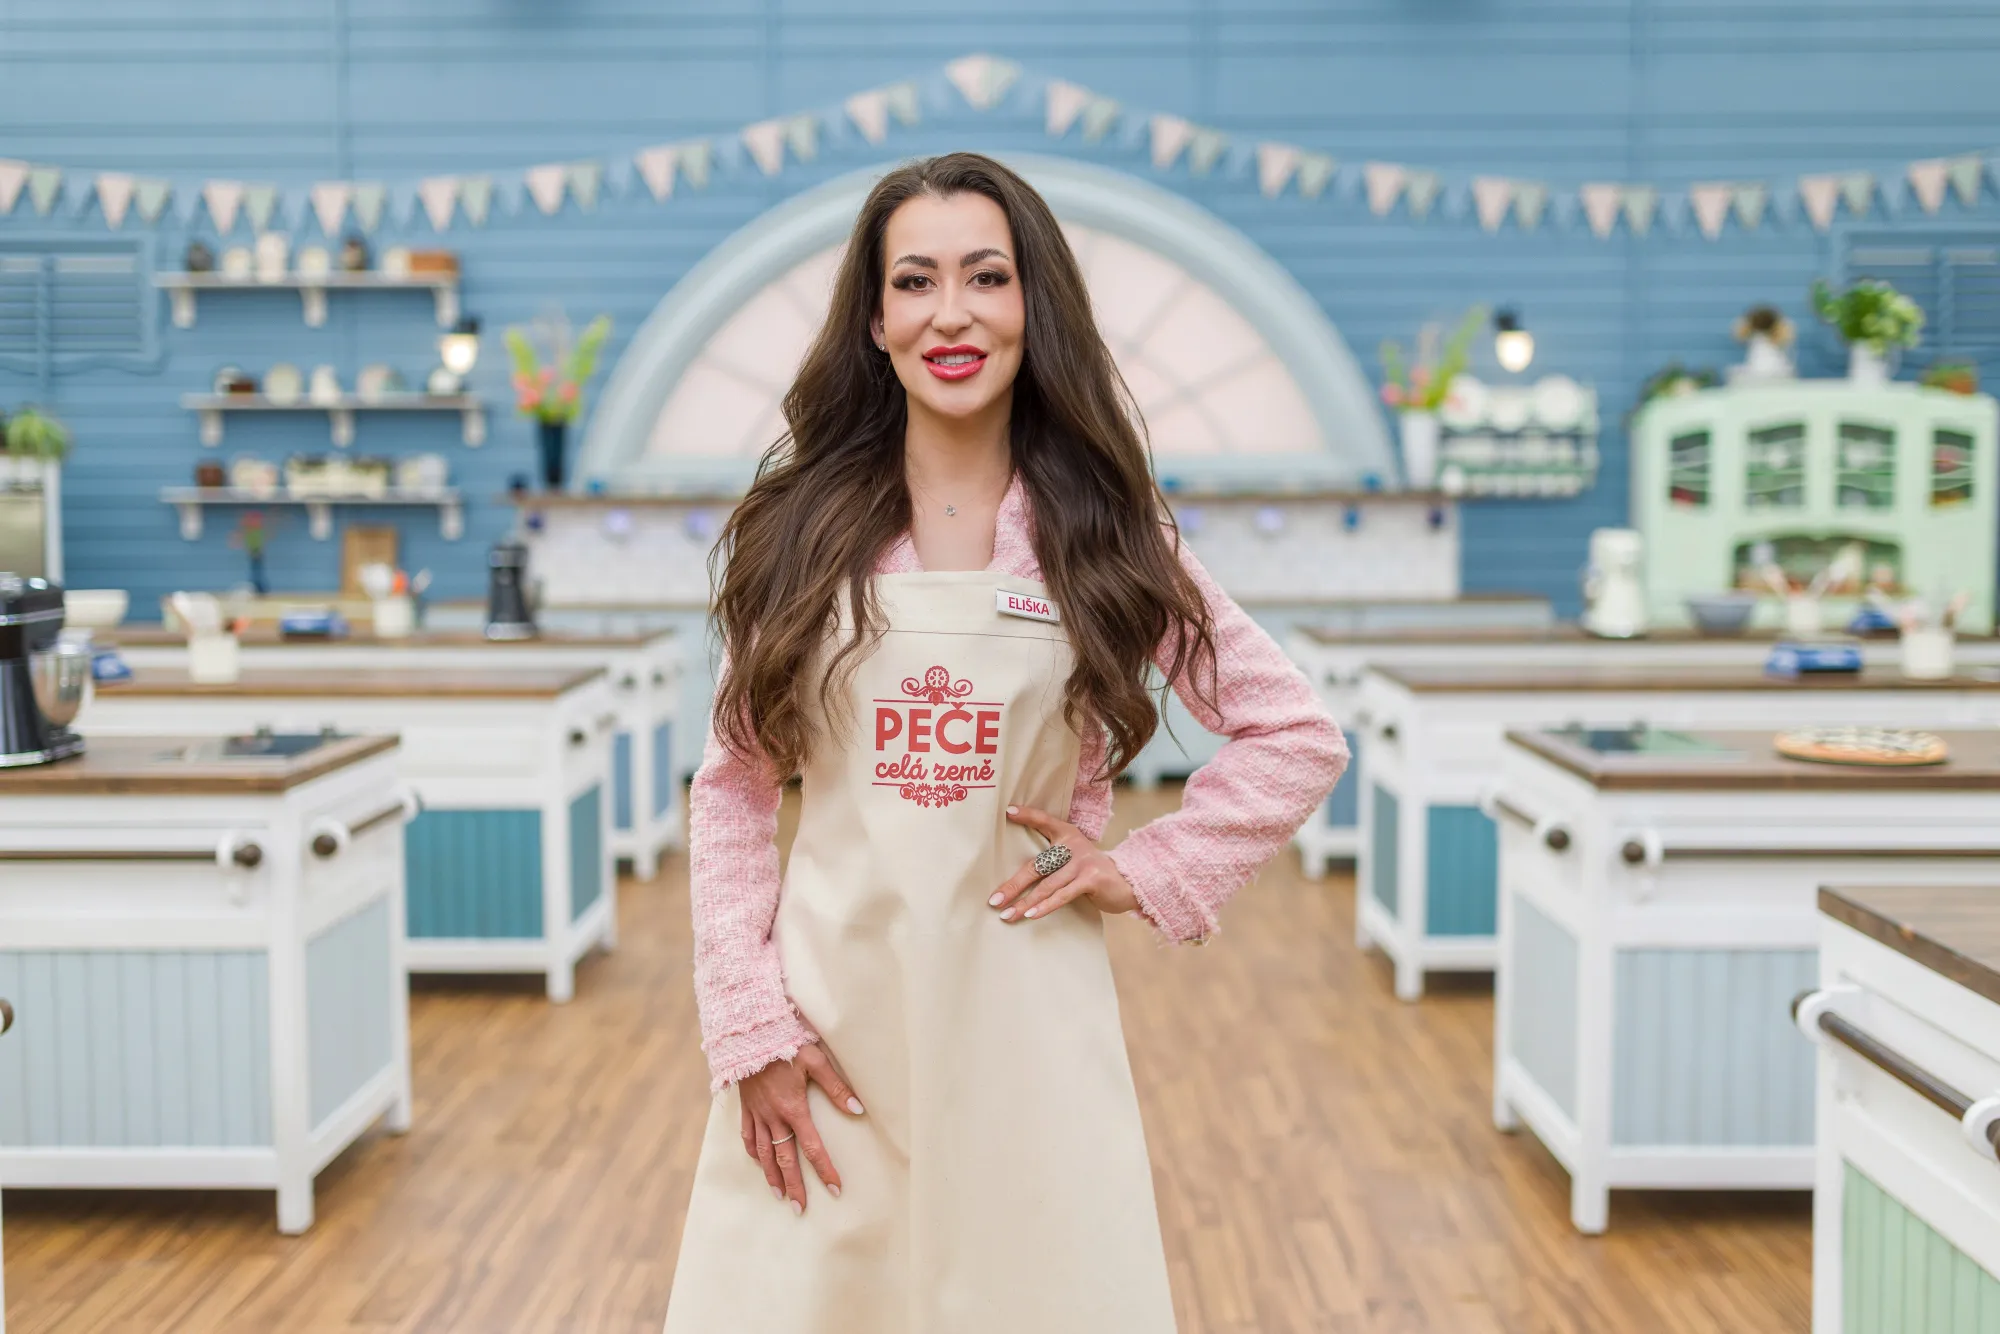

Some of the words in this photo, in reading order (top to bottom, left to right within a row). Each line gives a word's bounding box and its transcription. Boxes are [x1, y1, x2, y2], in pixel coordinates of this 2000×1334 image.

[1008, 596, 1050, 616] ELIŠKA
[875, 702, 1000, 754] PEČE
[875, 753, 928, 780] celá
[933, 759, 995, 781] země
